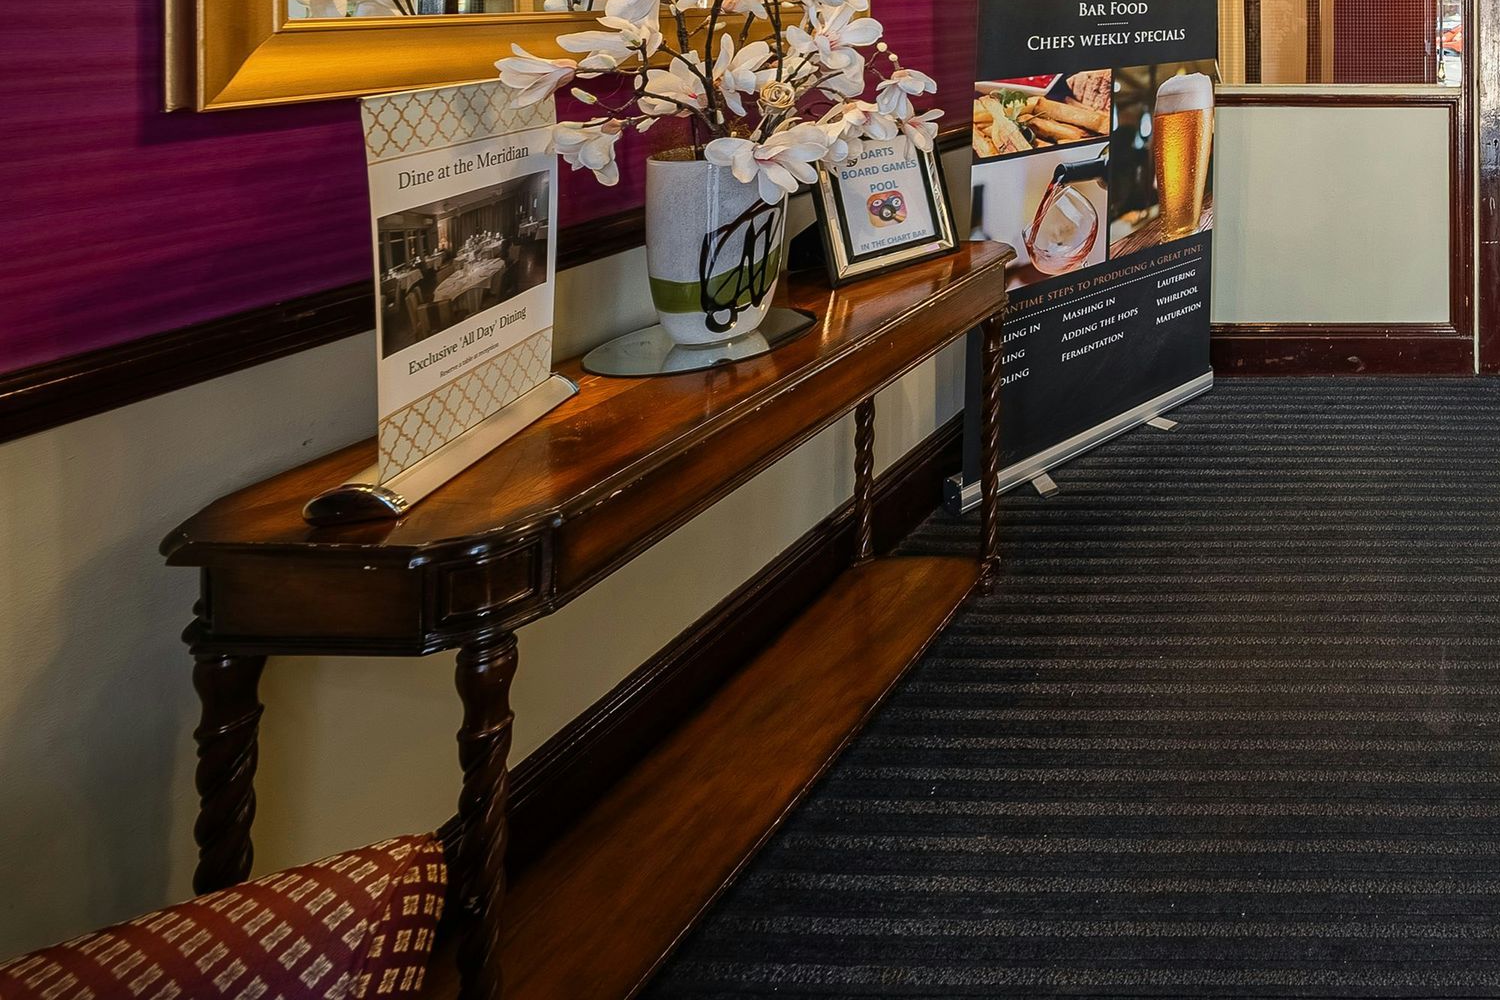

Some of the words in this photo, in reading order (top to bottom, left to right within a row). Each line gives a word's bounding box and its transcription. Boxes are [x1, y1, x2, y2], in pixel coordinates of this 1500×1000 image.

[1079, 3, 1106, 17] BAR
[1110, 1, 1149, 16] FOOD
[1027, 34, 1076, 52] CHEFS
[1080, 32, 1131, 47] WEEKLY
[1134, 28, 1186, 44] SPECIALS
[860, 146, 894, 160] DARTS
[398, 167, 434, 190] Dine
[438, 166, 450, 180] at
[453, 158, 473, 176] the
[476, 144, 529, 171] Meridian
[841, 165, 880, 180] BOARD
[881, 159, 918, 174] GAMES
[869, 180, 899, 193] POOL
[861, 243, 870, 251] IN
[872, 239, 886, 249] THE
[887, 233, 912, 244] CHART
[913, 229, 927, 239] BAR
[1001, 294, 1044, 320] ANTIME
[1048, 286, 1074, 301] STEPS
[1077, 281, 1091, 293] TO
[1093, 263, 1147, 287] PRODUCING
[1149, 258, 1155, 268] A
[1157, 250, 1181, 265] GREAT
[1157, 269, 1196, 288] LAUTERING
[1156, 286, 1198, 306] WHIRLPOOL
[1062, 300, 1104, 322] MASHING
[1105, 297, 1116, 308] IN
[1156, 301, 1202, 325] MATURATION
[1001, 328, 1027, 344] LING
[1029, 323, 1041, 334] IN
[1061, 322, 1098, 343] ADDING
[1100, 315, 1116, 329] THE
[1117, 307, 1139, 321] HOPS
[408, 343, 458, 375] Exclusive
[460, 331, 475, 348] 'All
[477, 319, 498, 340] Day'
[499, 307, 527, 329] Dining
[1061, 331, 1124, 362] FERMENTATION
[1001, 349, 1026, 365] LING
[1000, 368, 1030, 387] OLING
